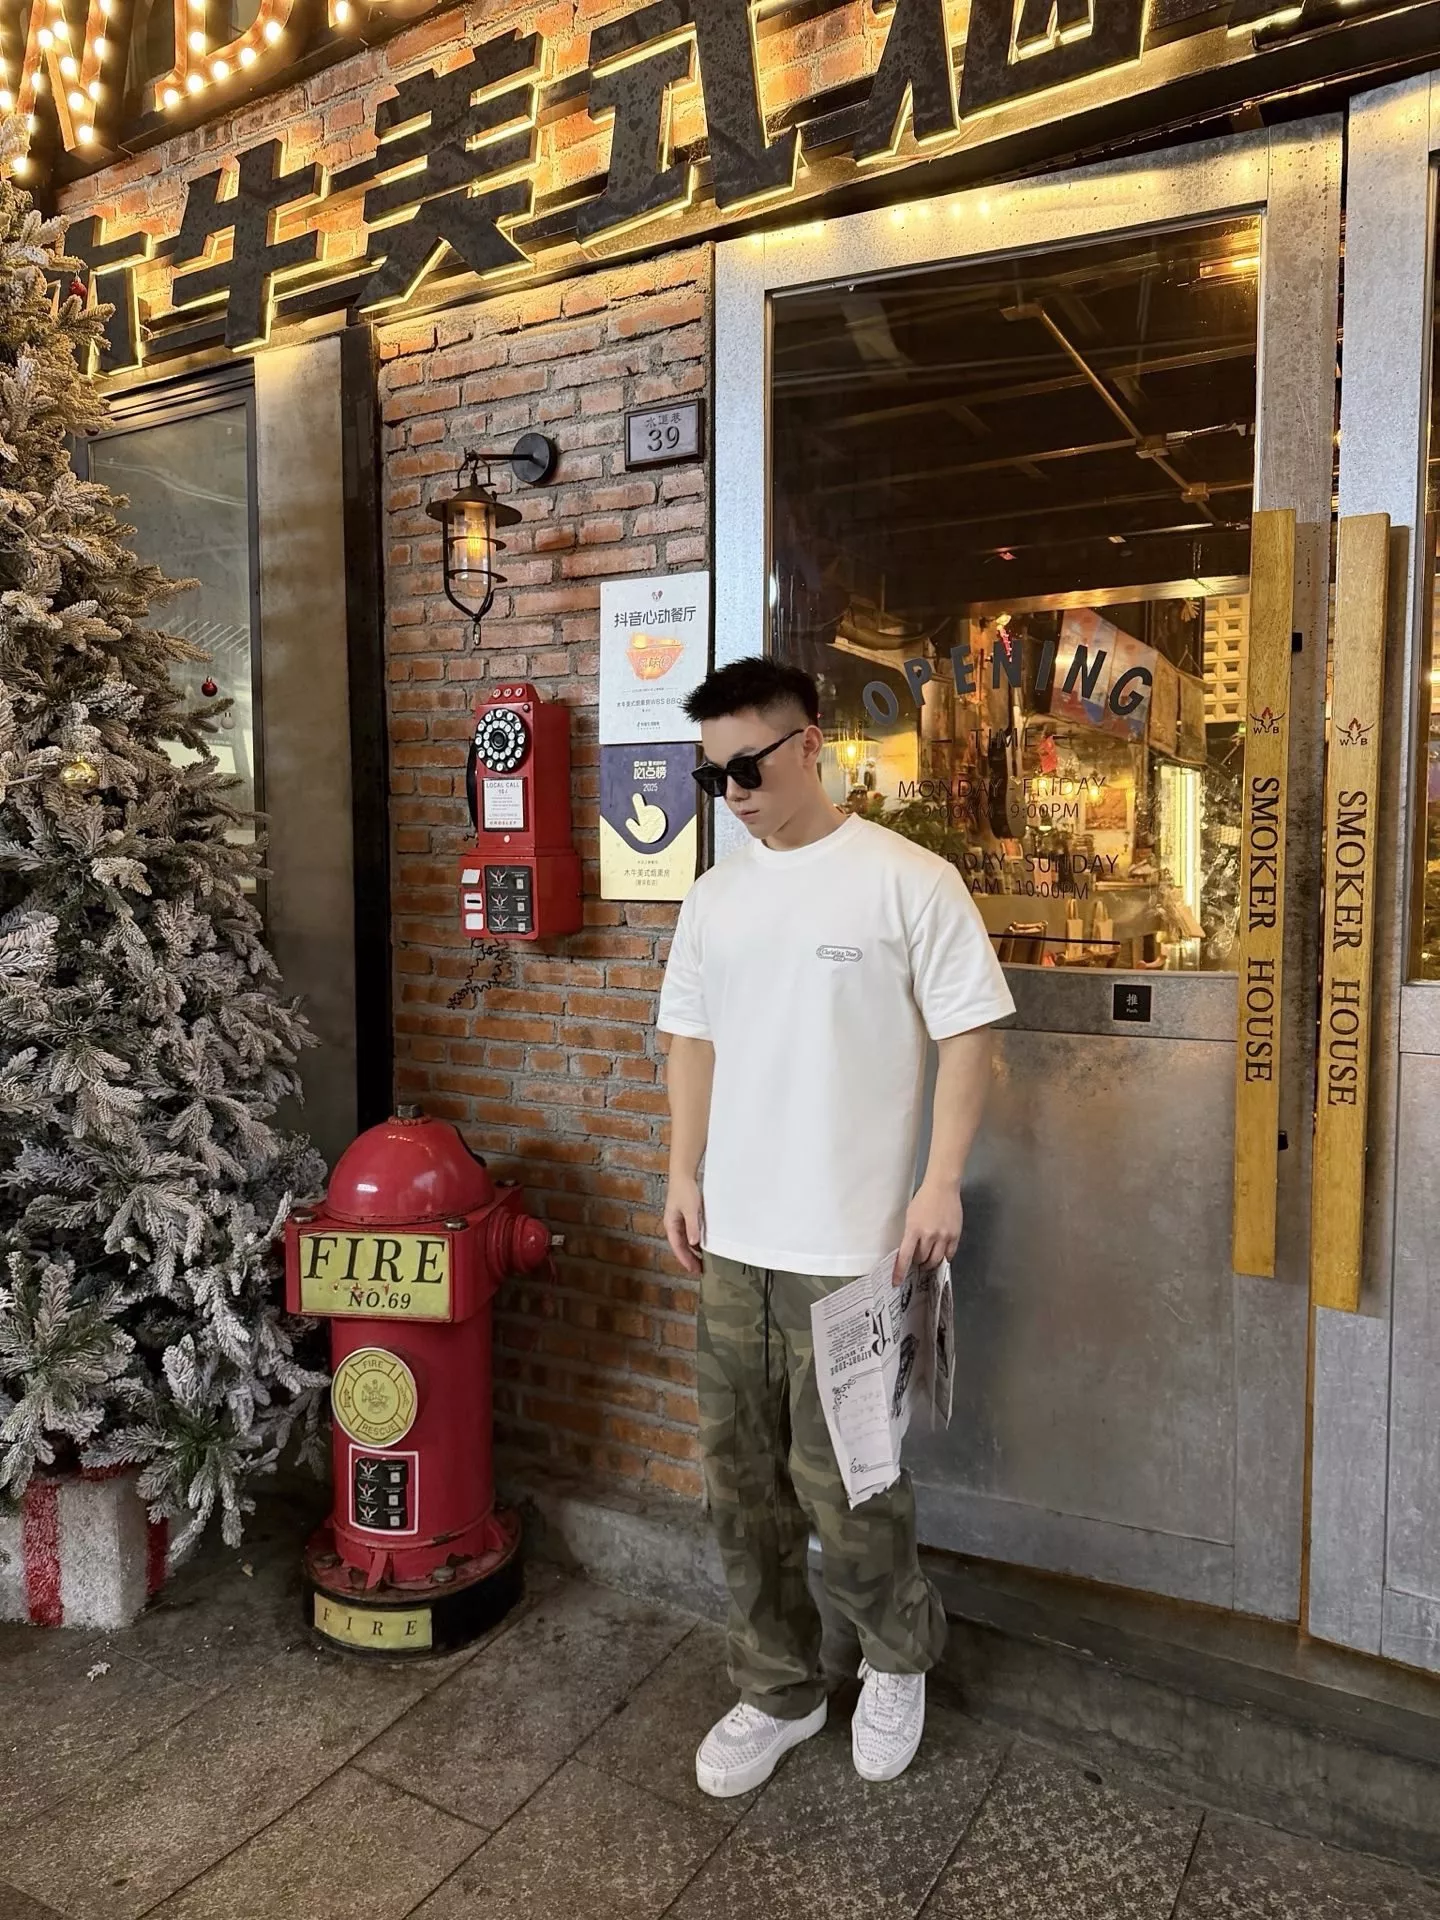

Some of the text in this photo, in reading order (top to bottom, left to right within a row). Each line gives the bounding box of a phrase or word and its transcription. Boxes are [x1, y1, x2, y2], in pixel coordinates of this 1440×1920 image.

[647, 426, 680, 452] 39
[614, 606, 697, 628] 抖音心动餐厅
[862, 639, 1153, 726] OPENING
[970, 727, 1038, 749] TIME
[1273, 726, 1279, 734] B
[1340, 737, 1368, 746] W B
[898, 778, 1002, 798] MONDAY
[1023, 776, 1106, 796] FRIDAY
[1010, 802, 1079, 819] 9:00PM
[947, 852, 1006, 872] RDAY
[1025, 853, 1119, 874] SUNDAY
[1016, 880, 1089, 901] 10:00PM
[1245, 776, 1279, 1083] SMOKER HOUSE
[1328, 790, 1368, 1106] SMOKER HOUSE
[1126, 993, 1138, 1006] 推
[303, 1236, 446, 1284] FIRE
[347, 1290, 412, 1310] NO.69
[362, 1359, 384, 1369] FIRE
[362, 1422, 397, 1436] RESCUE
[323, 1607, 418, 1637] FIRE
